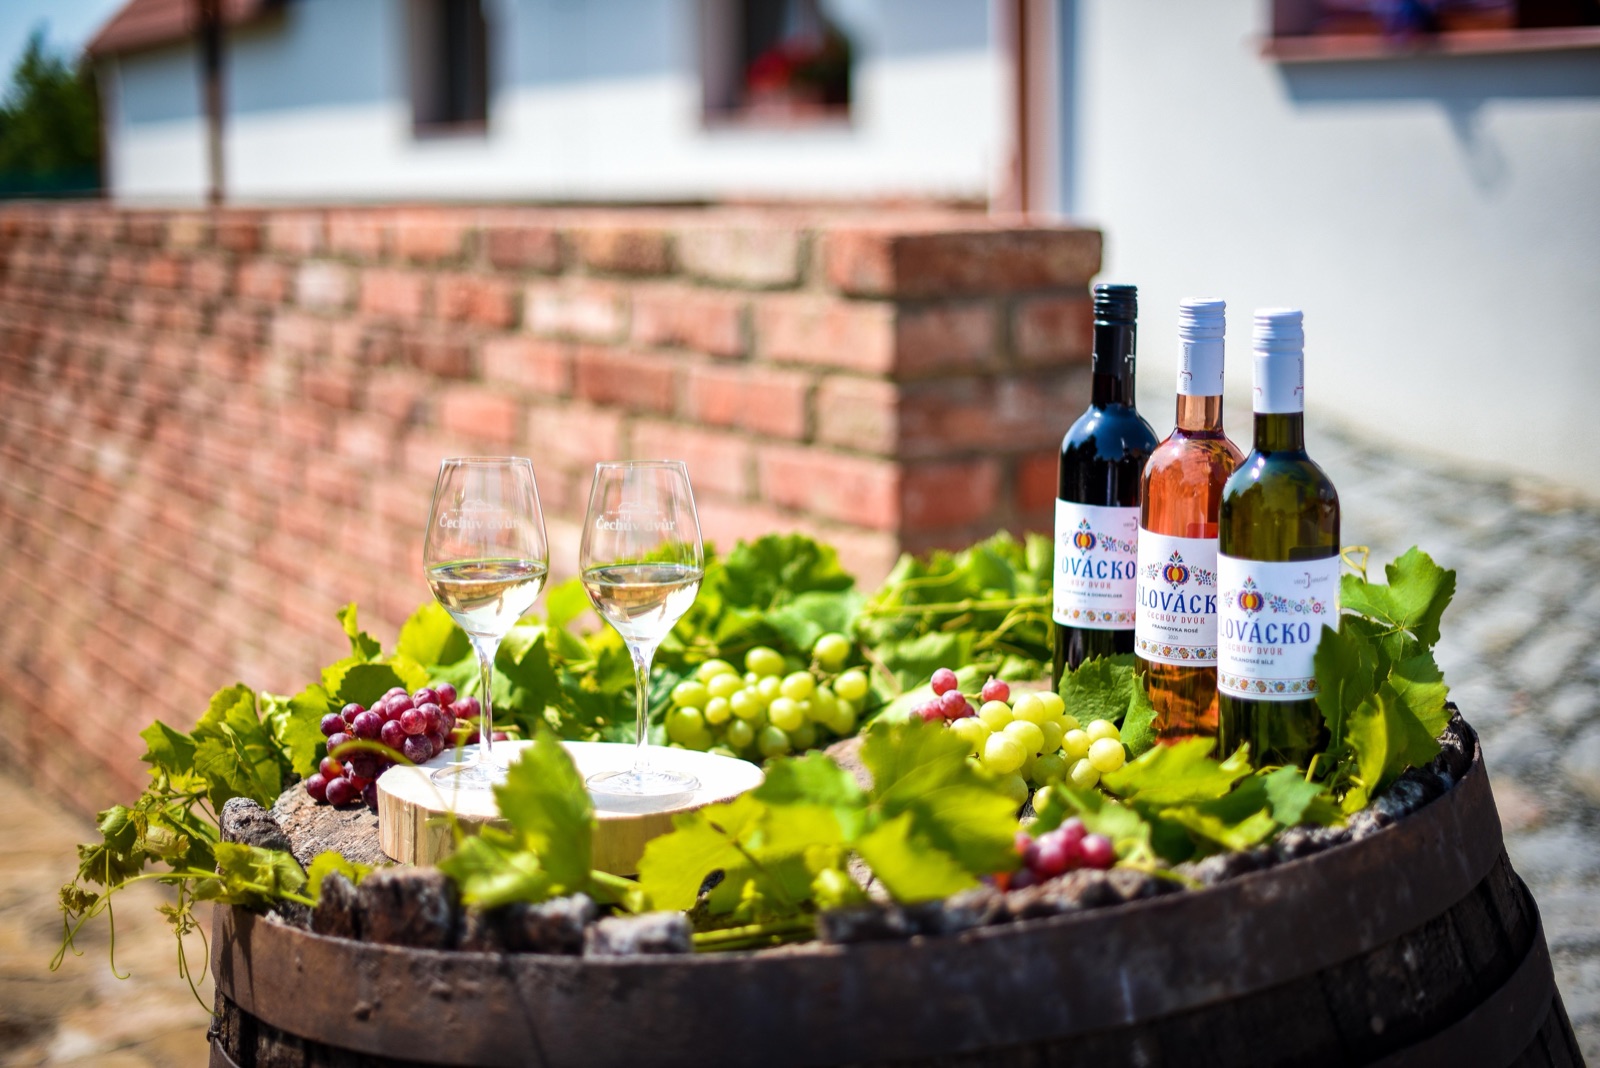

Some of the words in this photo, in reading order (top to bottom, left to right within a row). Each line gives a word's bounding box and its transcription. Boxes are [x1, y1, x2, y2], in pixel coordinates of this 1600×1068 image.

[1061, 555, 1136, 580] OVÁCKO
[1151, 623, 1183, 632] FRANKOVKA
[1220, 616, 1311, 644] LOVÁCKO
